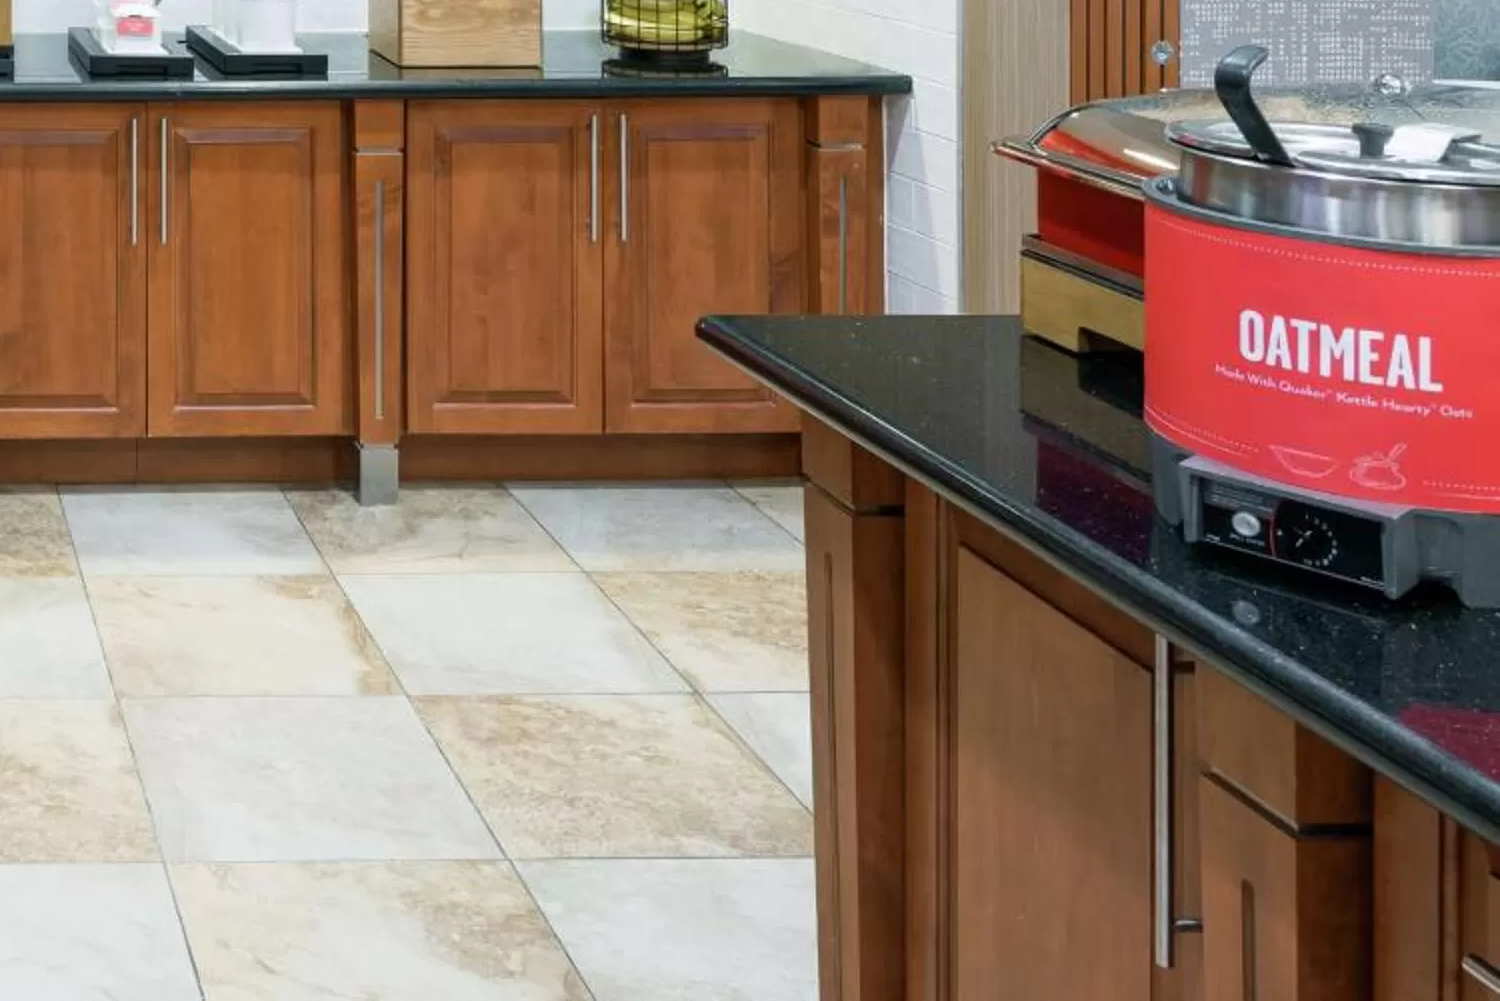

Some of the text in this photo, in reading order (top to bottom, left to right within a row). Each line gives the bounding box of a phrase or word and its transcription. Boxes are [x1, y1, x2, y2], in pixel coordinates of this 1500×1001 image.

[1238, 309, 1444, 393] OATMEAL
[1215, 362, 1245, 381] Made
[1247, 372, 1277, 389] With
[1336, 391, 1378, 408] Kettle
[1439, 404, 1474, 419] Oats
